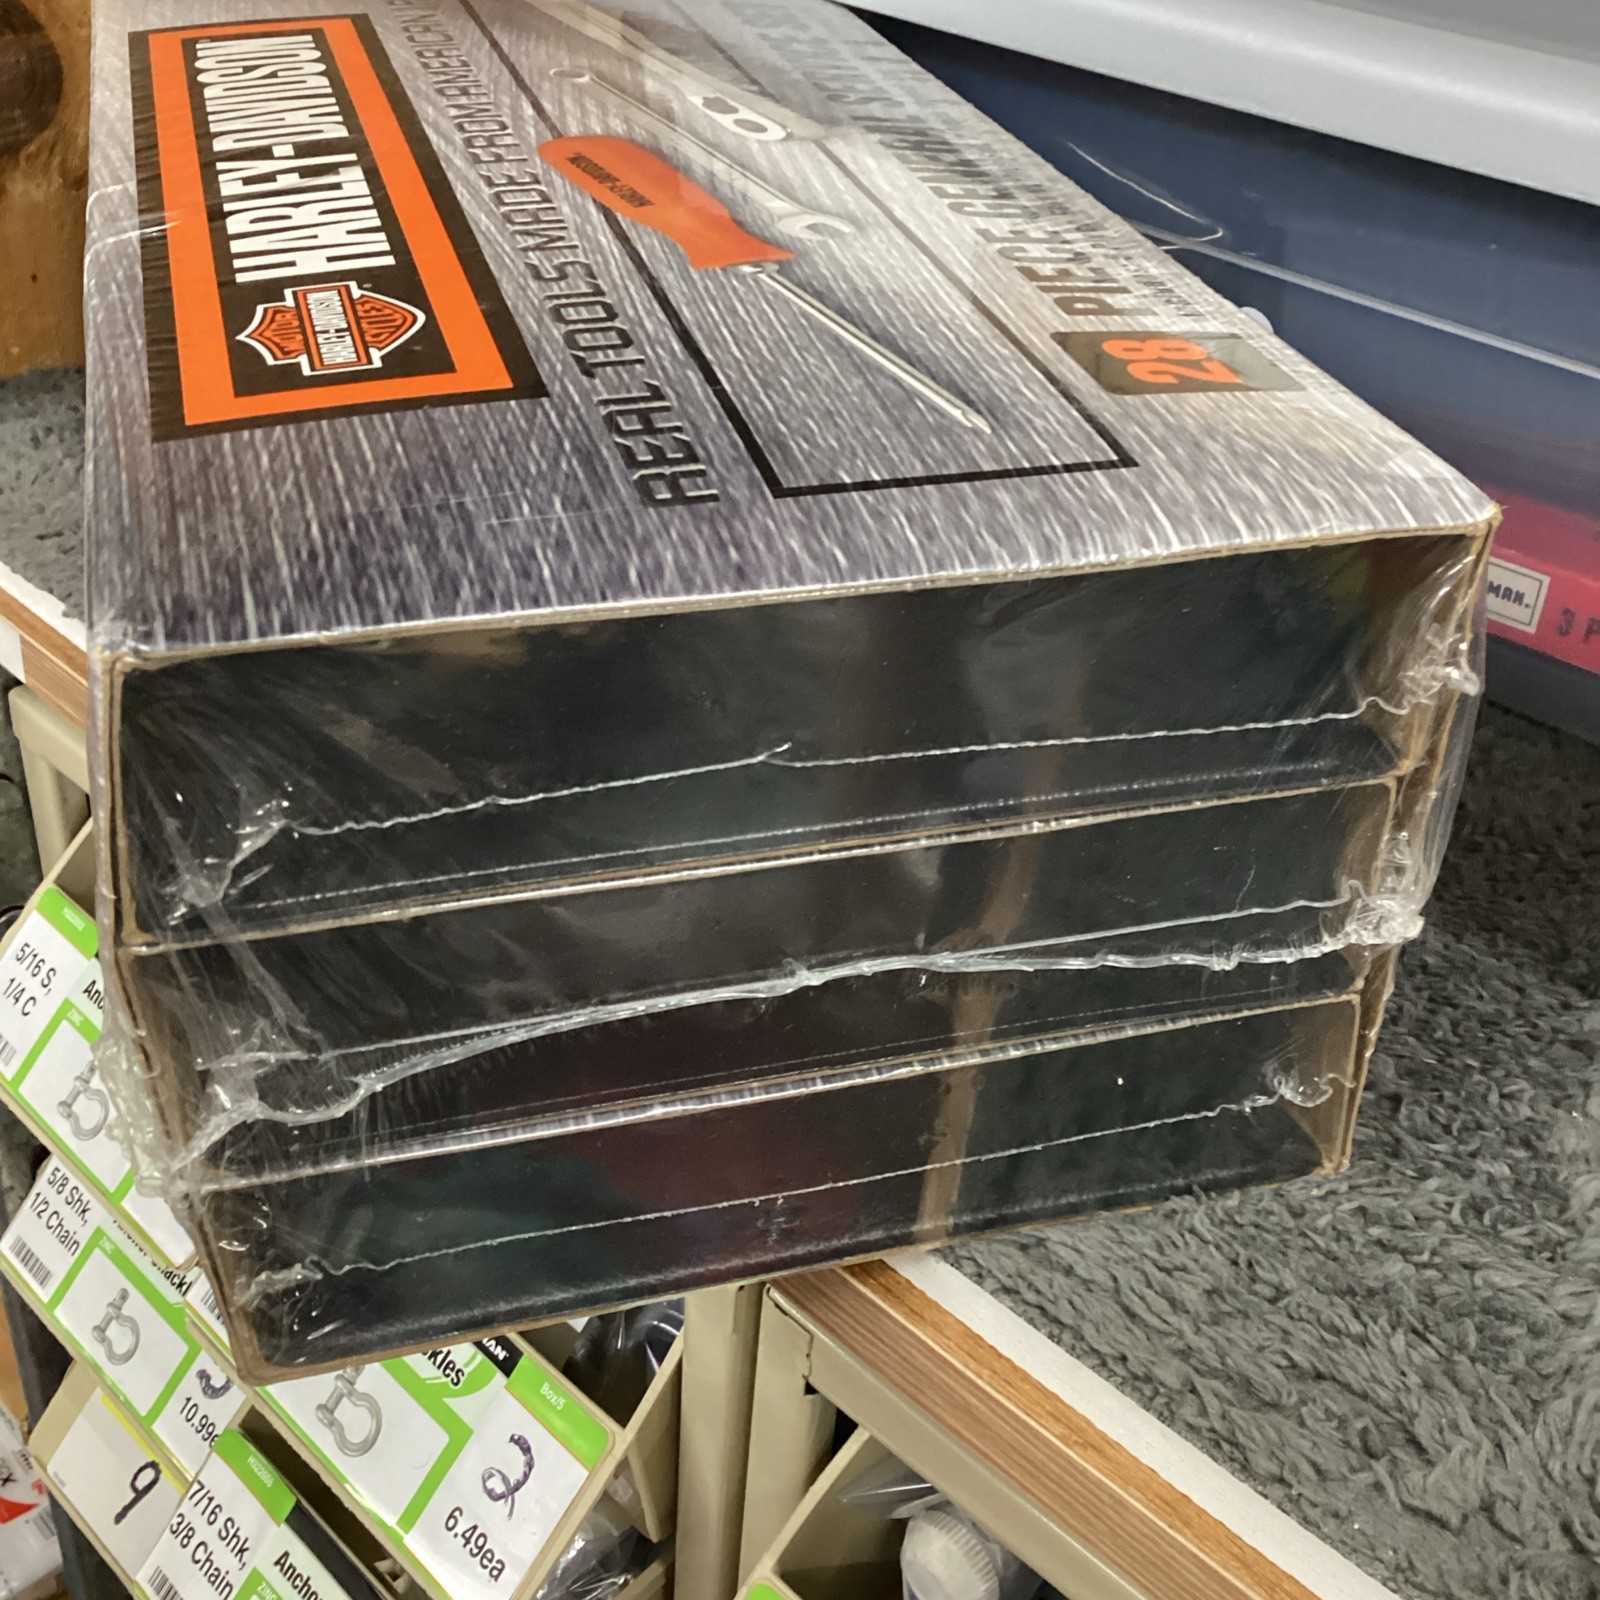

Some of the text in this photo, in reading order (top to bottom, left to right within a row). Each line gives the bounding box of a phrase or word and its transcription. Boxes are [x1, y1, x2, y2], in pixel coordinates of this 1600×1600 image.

[391, 7, 488, 97] AMERICAN
[194, 34, 396, 283] HARLEY-DAVIDSON
[445, 102, 528, 164] FROM
[850, 114, 1042, 219] GENERAL
[479, 169, 580, 250] MADE
[977, 227, 1158, 316] PIECE
[306, 290, 358, 366] HARLEY-DAVIDSON
[523, 259, 645, 379] TOOLS
[1101, 338, 1243, 384] 28
[594, 378, 720, 508] REAL
[3, 977, 37, 1017] 1/4 C
[15, 943, 57, 996] 5/16 S,
[30, 1192, 80, 1256] 1/2 Chain
[47, 1167, 91, 1227] 5/8 Shk,
[539, 1382, 566, 1411] Box/5
[114, 1460, 163, 1526] 9
[481, 1433, 535, 1521] 2
[170, 1512, 234, 1600] 3/8 Chain
[188, 1479, 250, 1571] 7/16 Shk,
[444, 1506, 506, 1582] 6.49ea
